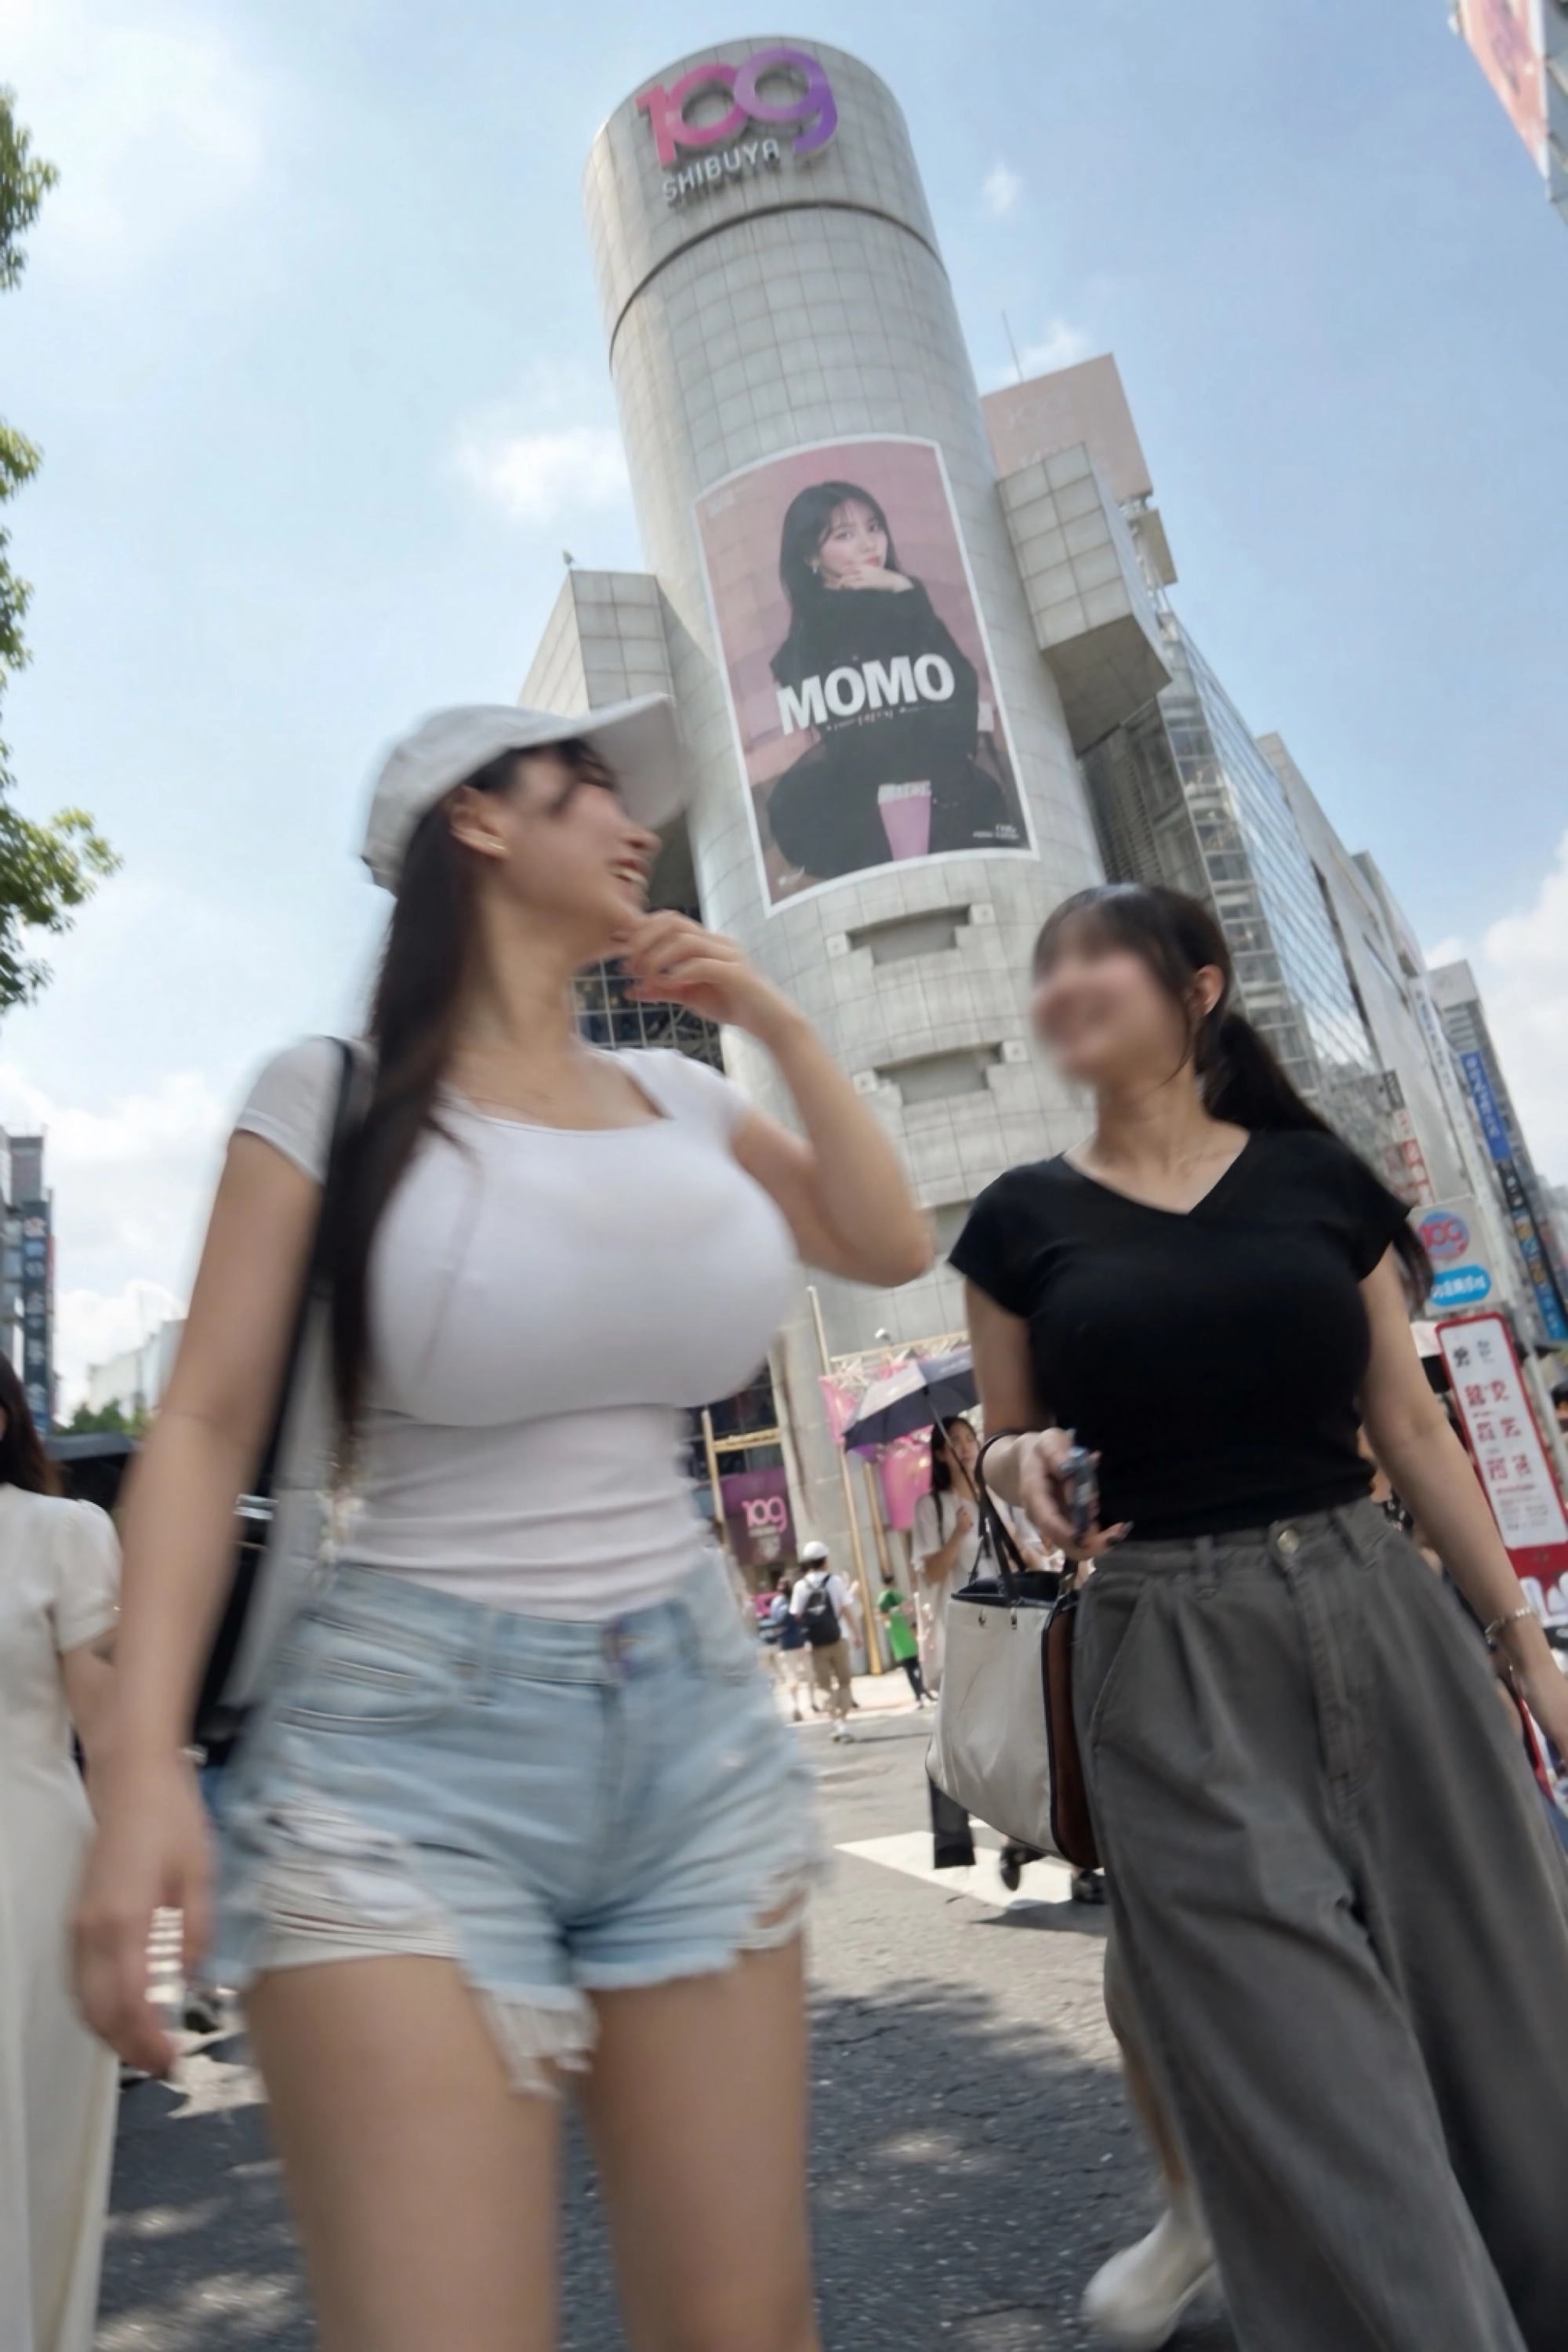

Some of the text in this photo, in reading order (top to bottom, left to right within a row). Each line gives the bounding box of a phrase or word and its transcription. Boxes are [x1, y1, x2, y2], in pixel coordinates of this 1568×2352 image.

[635, 47, 837, 167] 109
[663, 138, 779, 201] SHIBUYA
[776, 654, 955, 735] MOMO
[741, 1496, 787, 1533] 109
